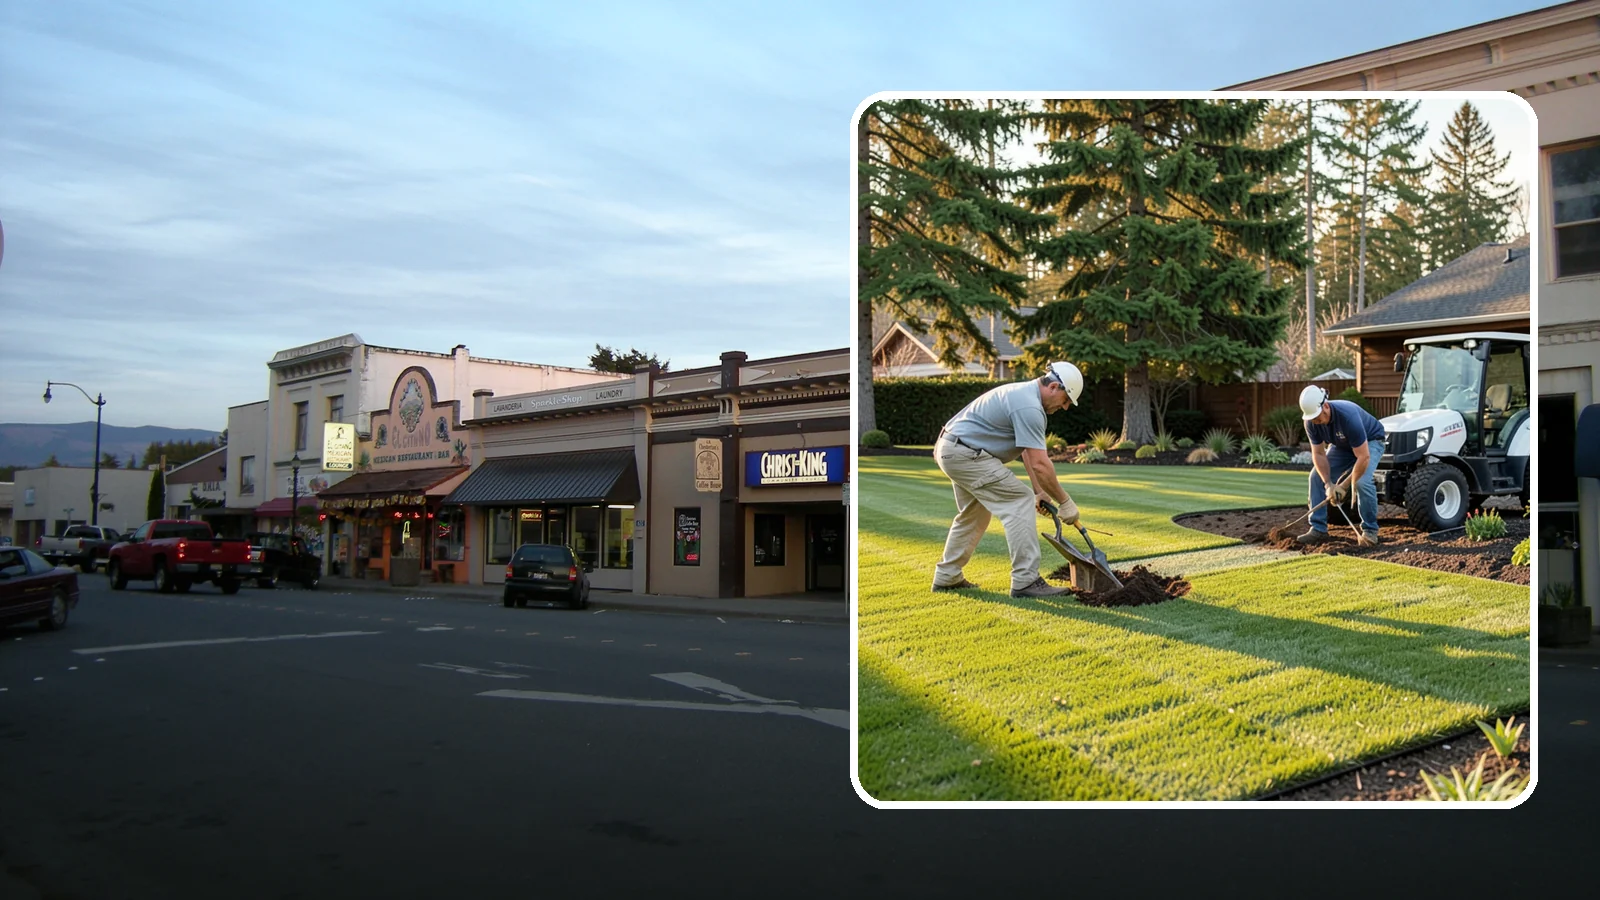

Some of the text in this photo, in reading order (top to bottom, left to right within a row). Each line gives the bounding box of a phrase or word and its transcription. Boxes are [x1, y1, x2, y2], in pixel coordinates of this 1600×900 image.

[562, 394, 582, 404] Shop
[595, 389, 623, 400] LAUNDRY
[493, 402, 522, 412] LAVANDERIA
[373, 455, 396, 464] MEXICAN
[397, 452, 434, 462] RESTAURANT
[438, 450, 450, 459] BAR
[761, 450, 827, 478] CHRIST KING
